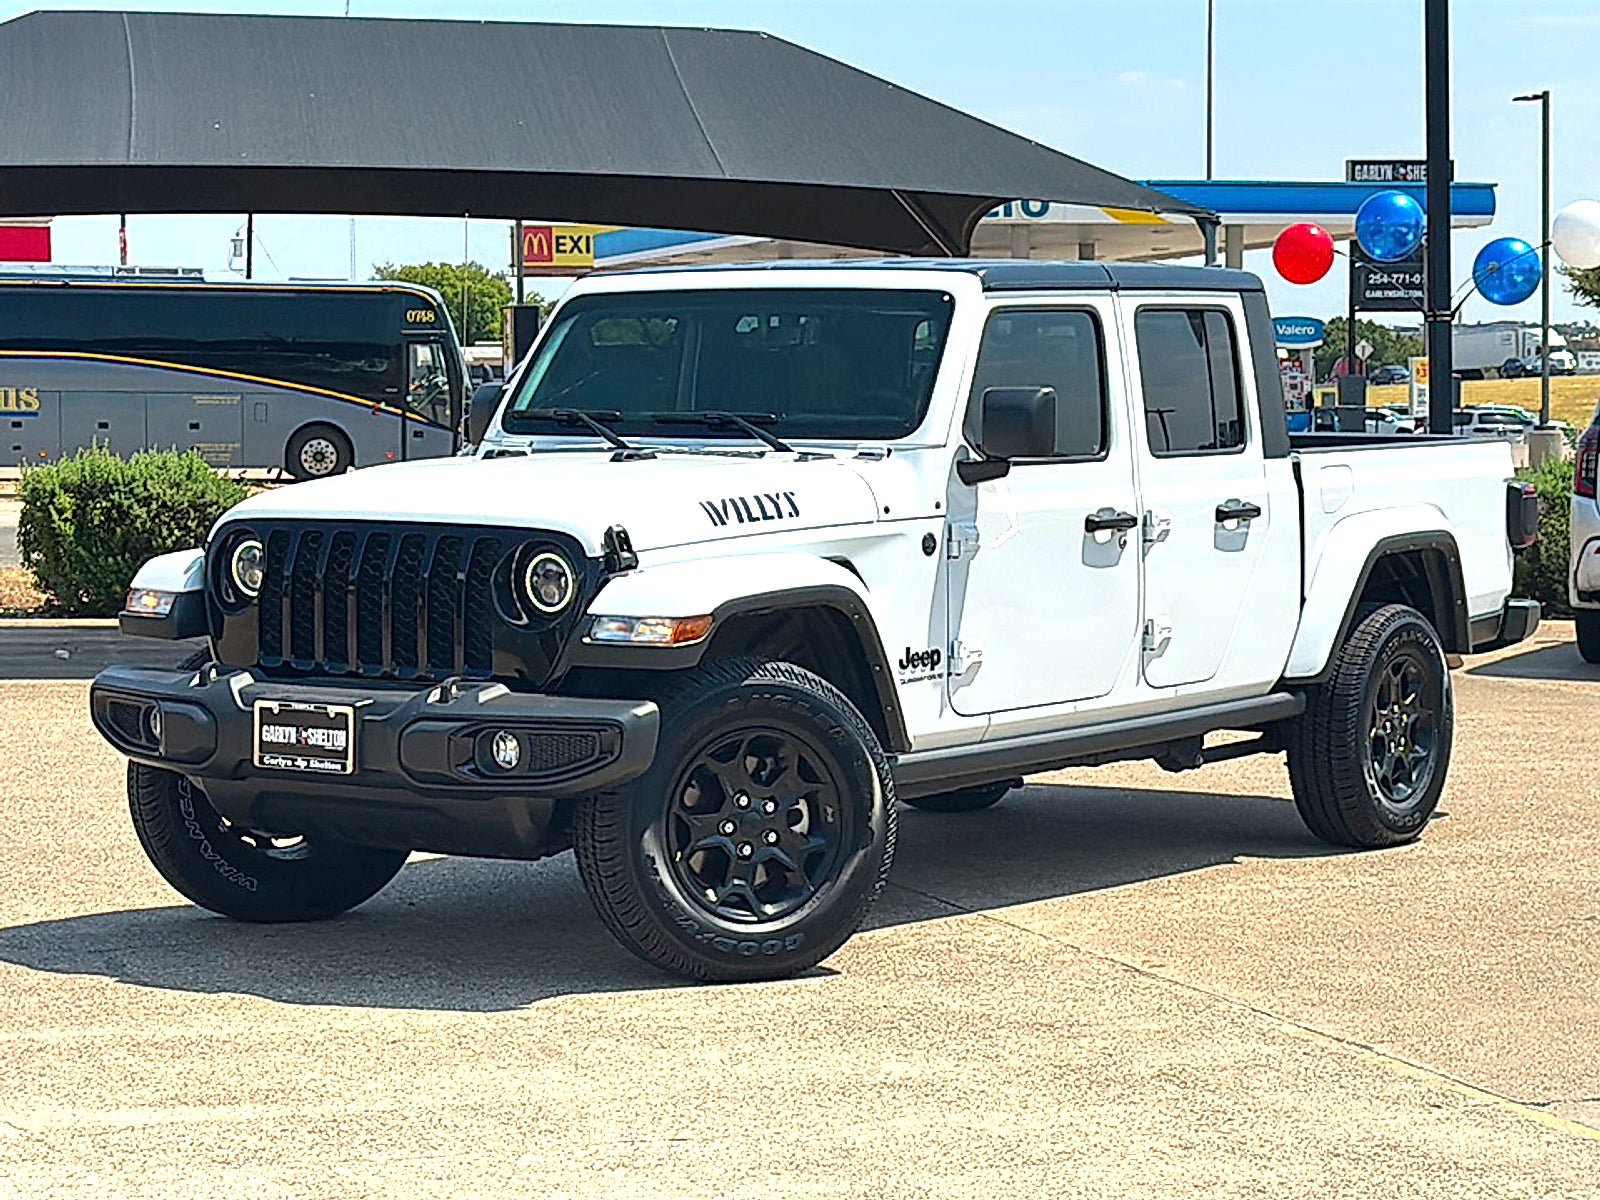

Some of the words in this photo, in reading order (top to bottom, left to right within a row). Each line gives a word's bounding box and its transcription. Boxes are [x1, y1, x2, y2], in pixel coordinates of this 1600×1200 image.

[555, 235, 591, 254] EXI
[1276, 324, 1315, 335] Valero
[698, 491, 800, 527] WILLYS
[898, 646, 941, 672] Jeep
[262, 724, 297, 744] GARLYN
[307, 727, 347, 748] SHELTON
